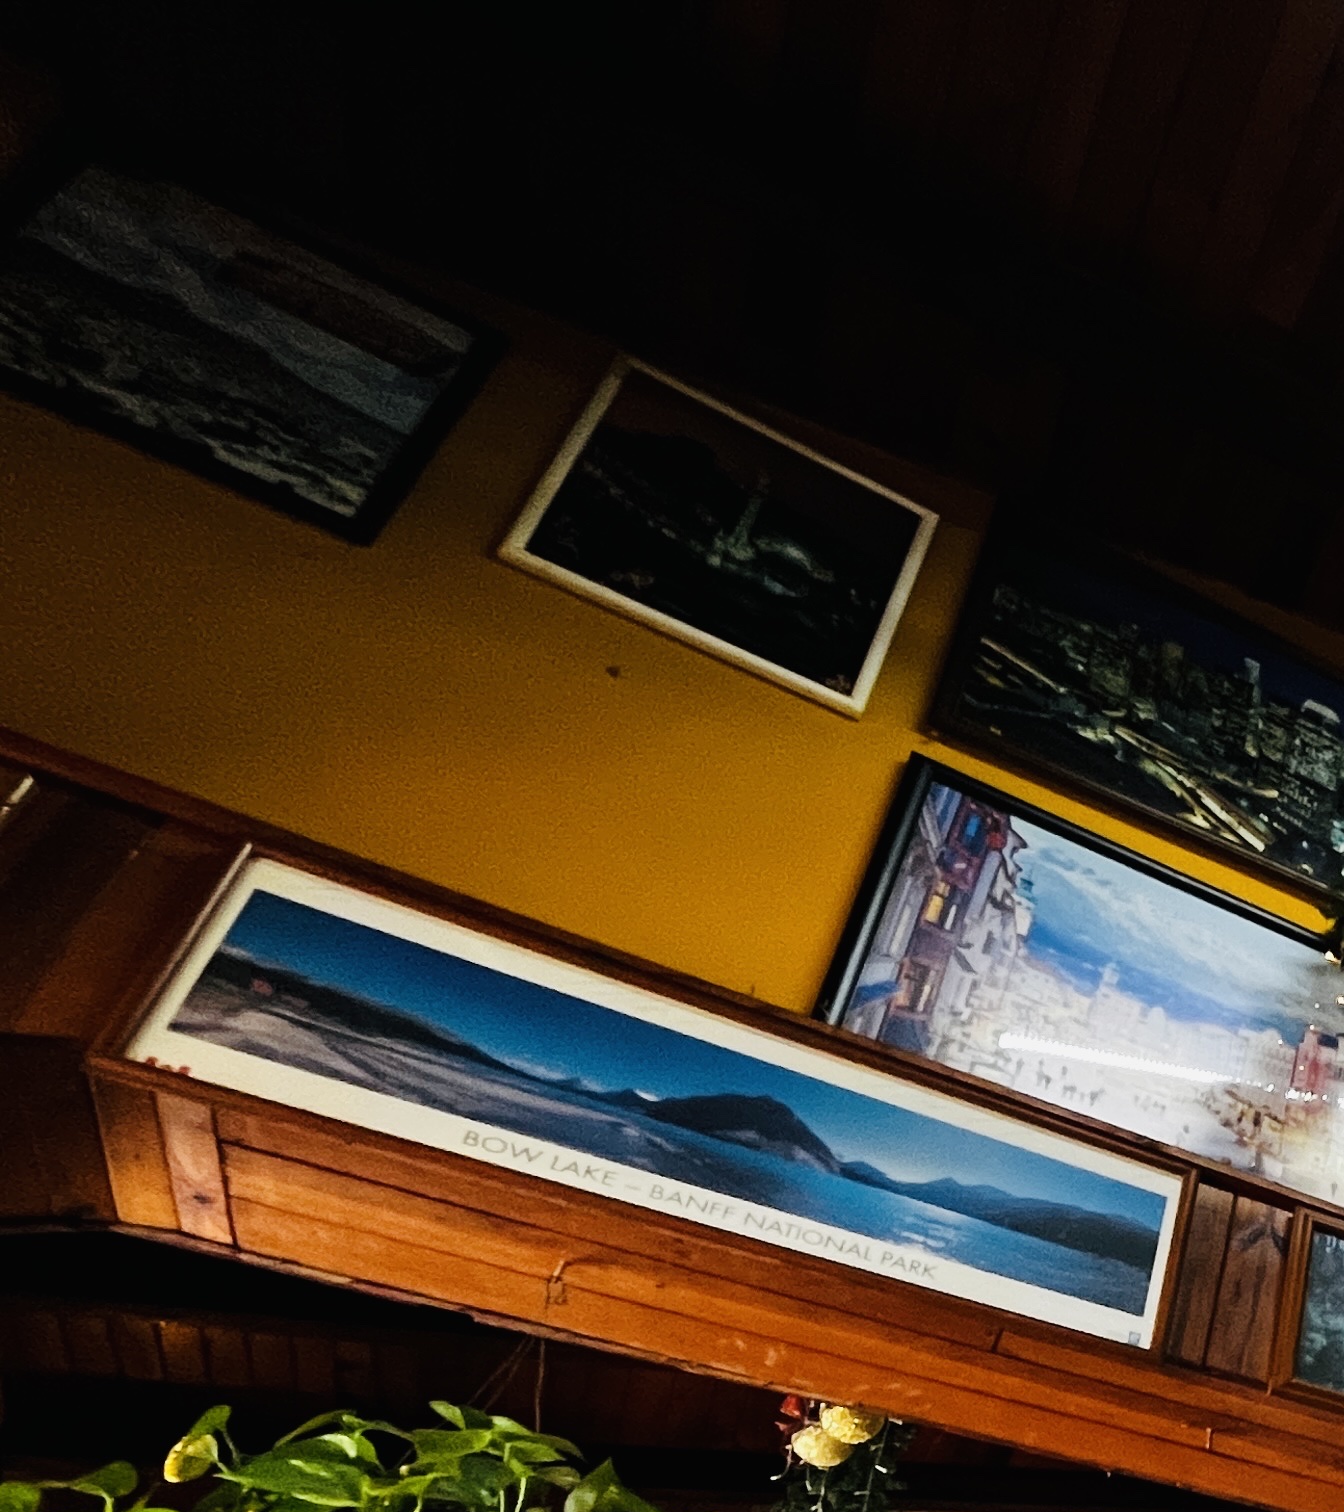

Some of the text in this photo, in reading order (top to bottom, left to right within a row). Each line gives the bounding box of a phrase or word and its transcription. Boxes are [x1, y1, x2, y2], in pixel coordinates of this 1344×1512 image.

[462, 1128, 545, 1164] BOW
[550, 1154, 618, 1188] LAKE
[648, 1184, 737, 1221] BANFF
[745, 1211, 873, 1264] NATIONAL
[880, 1251, 938, 1281] PARK
